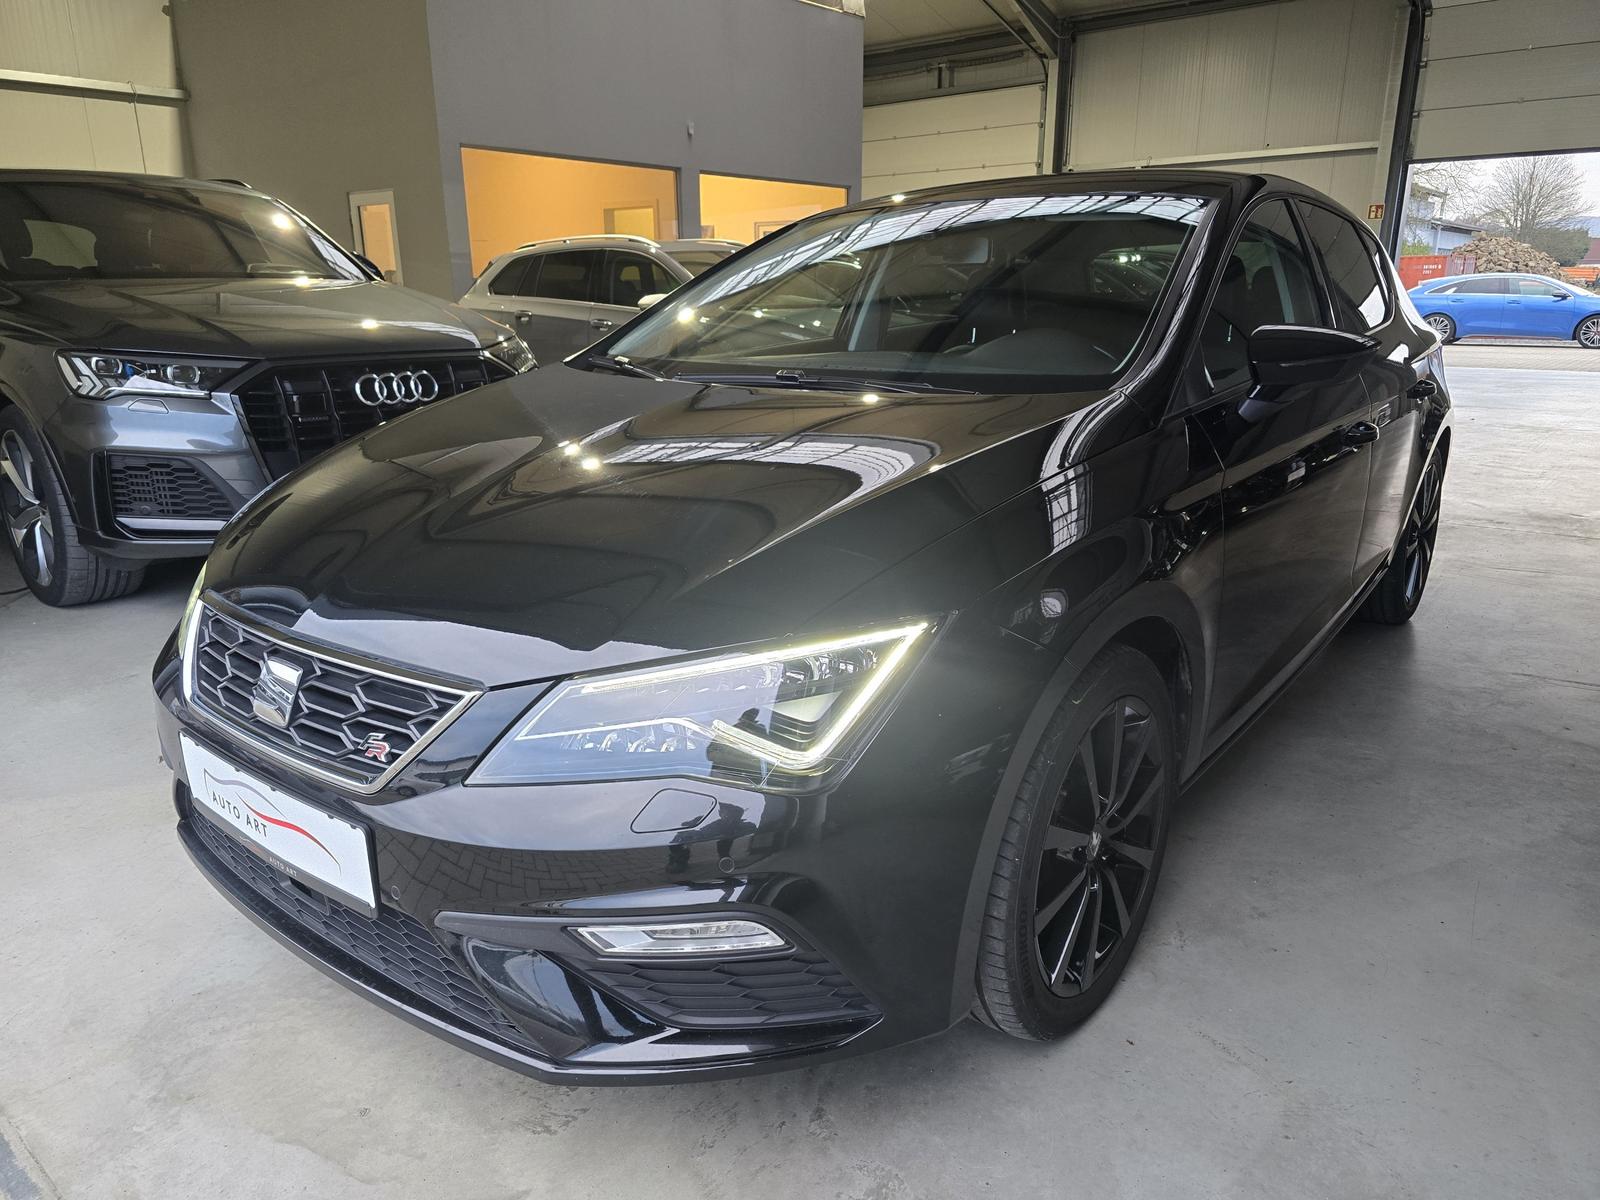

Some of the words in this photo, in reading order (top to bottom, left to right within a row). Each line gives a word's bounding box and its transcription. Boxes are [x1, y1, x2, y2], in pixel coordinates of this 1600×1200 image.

[358, 732, 390, 762] FR
[212, 790, 240, 819] AUTO
[246, 813, 267, 837] ART
[269, 856, 285, 870] AUTO
[286, 866, 297, 877] ART
